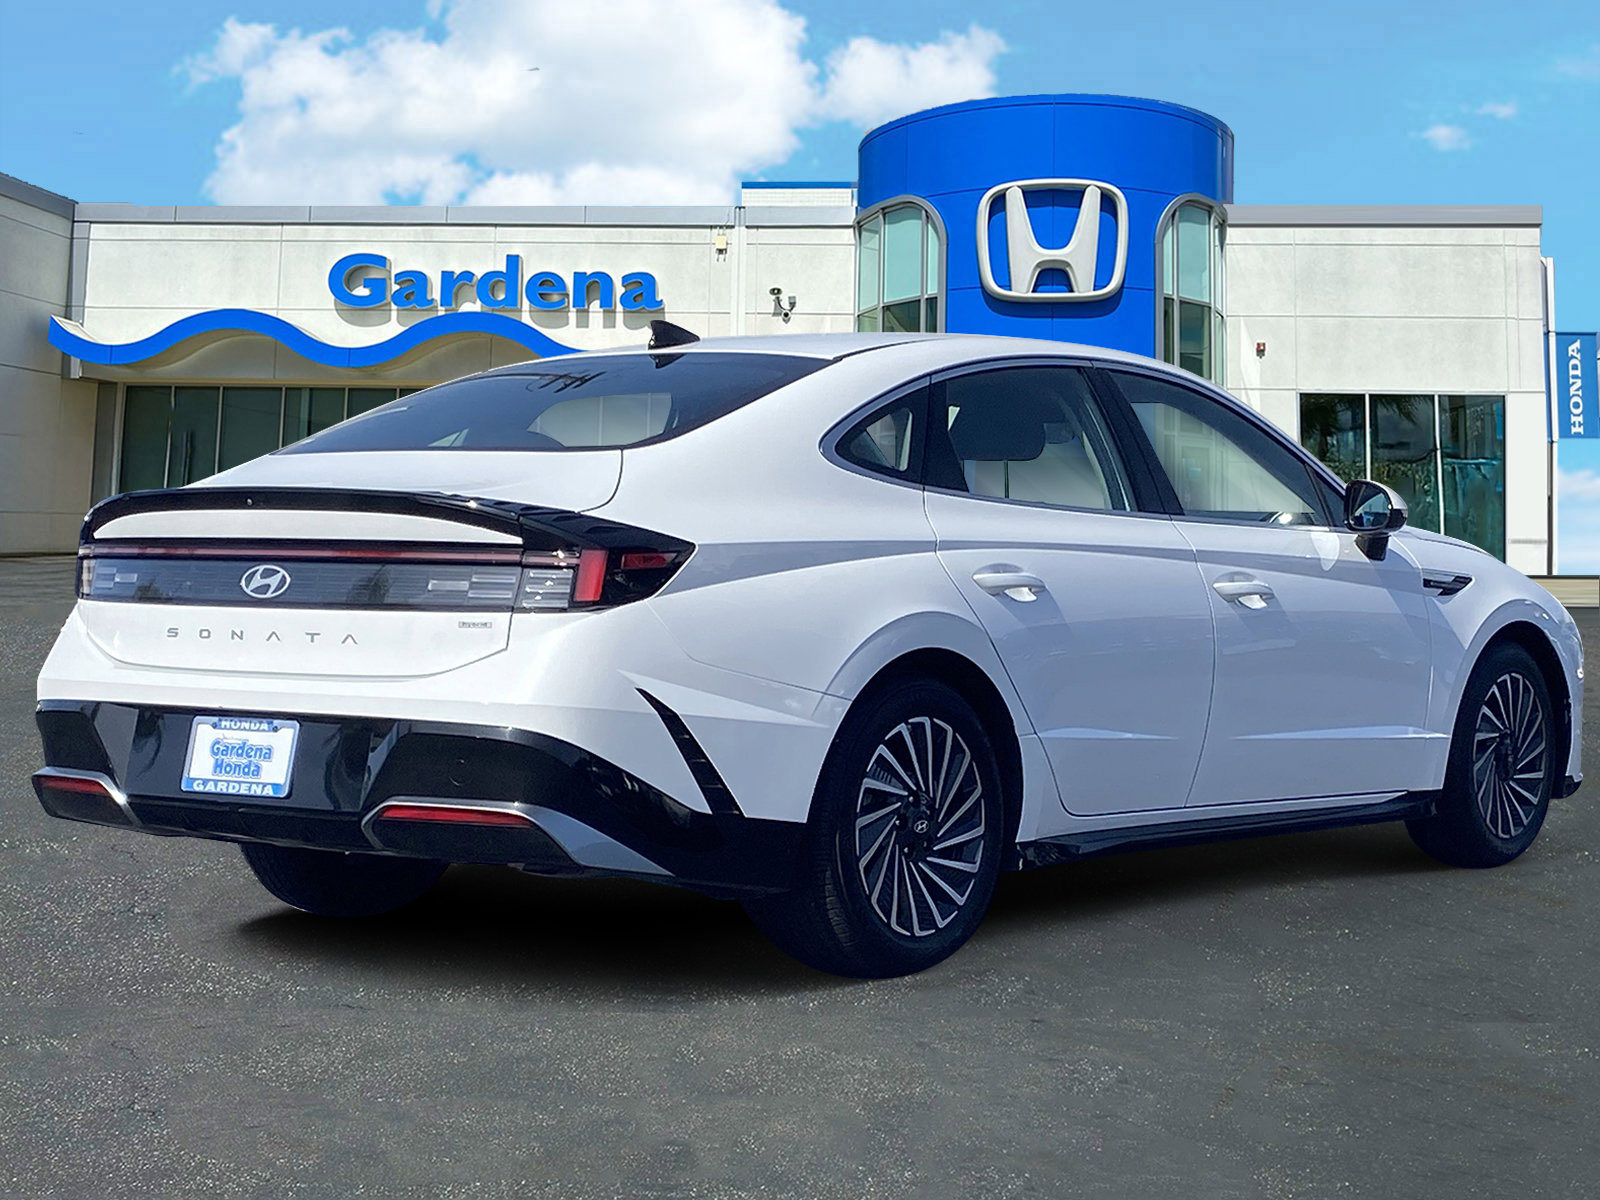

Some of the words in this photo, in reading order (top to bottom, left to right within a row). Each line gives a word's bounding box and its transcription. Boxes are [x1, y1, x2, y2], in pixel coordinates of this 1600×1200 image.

[328, 253, 664, 310] Gardena
[1568, 339, 1584, 435] HONDA
[166, 627, 358, 645] SONATA
[220, 719, 270, 731] HONDA
[211, 740, 273, 760] Gardena
[212, 759, 262, 777] Honda
[192, 780, 274, 796] GARDENA
